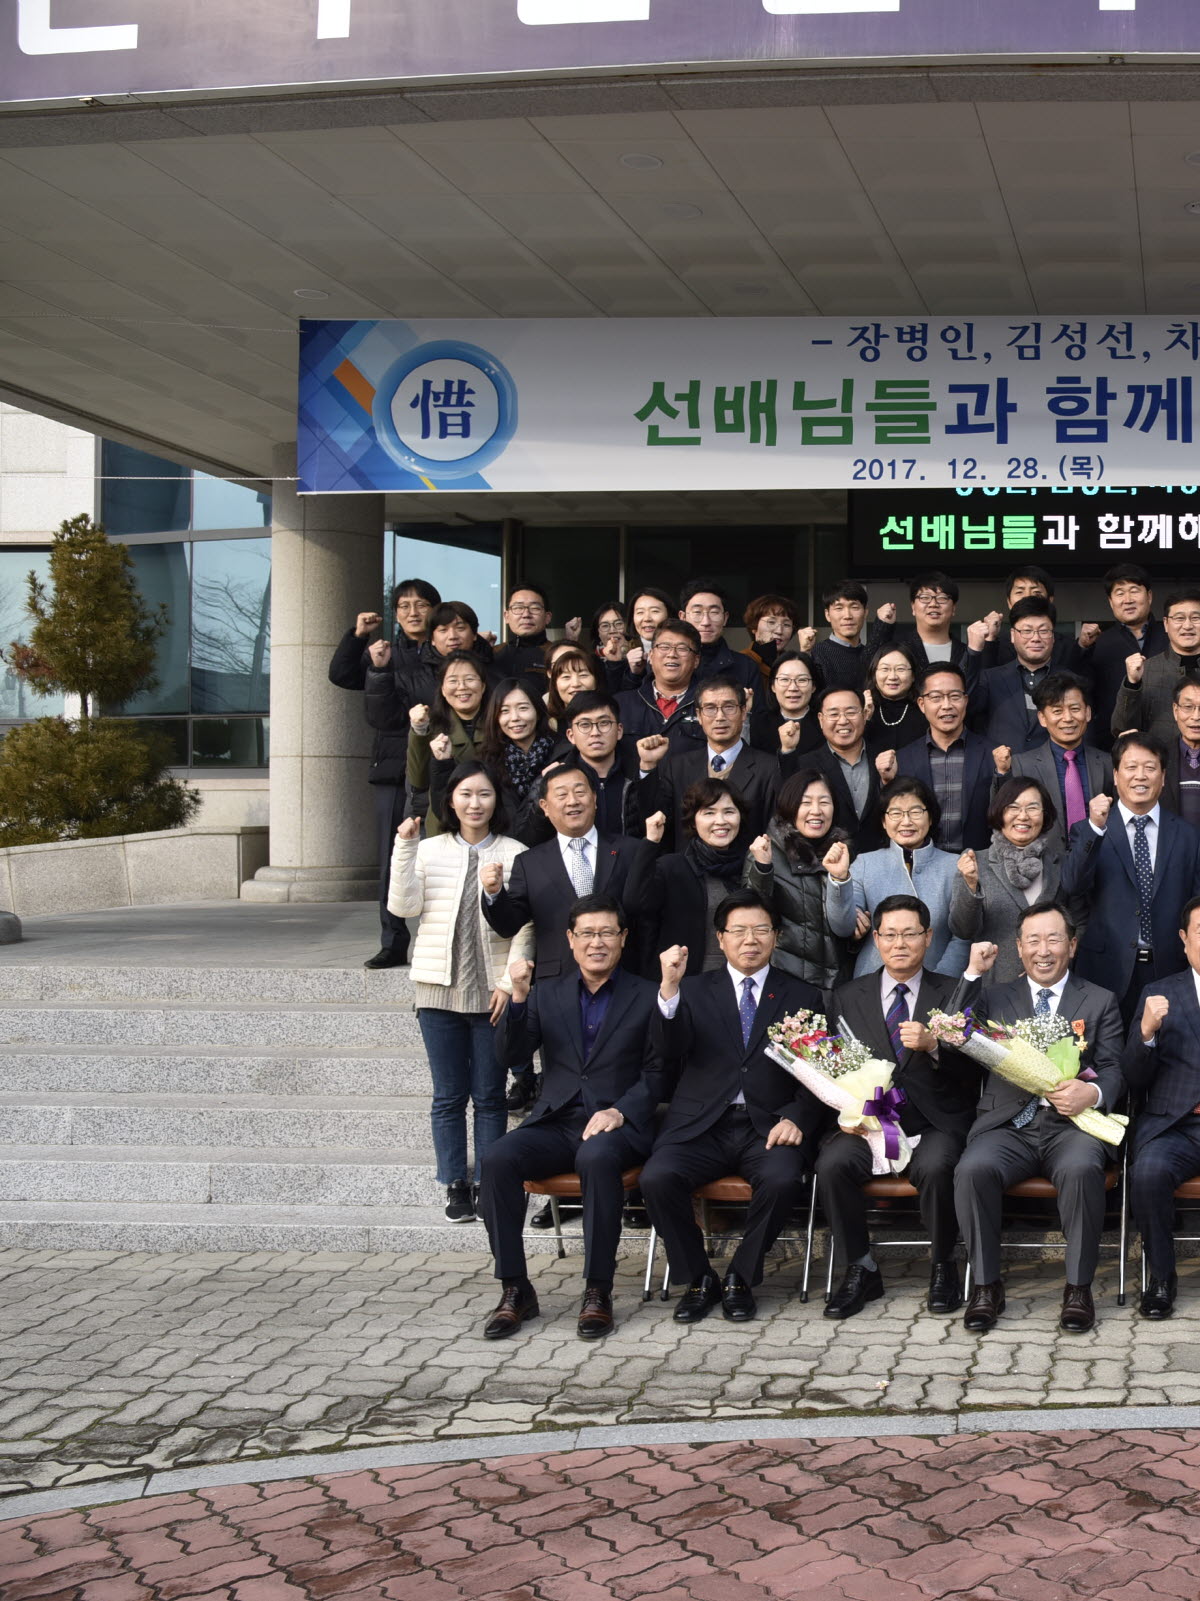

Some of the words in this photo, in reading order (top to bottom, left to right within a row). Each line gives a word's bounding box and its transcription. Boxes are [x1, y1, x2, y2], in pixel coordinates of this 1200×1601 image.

[410, 379, 476, 439] 惜
[634, 378, 1017, 446] 선배님들과
[852, 458, 926, 481] 2017.
[948, 458, 986, 480] 12.
[879, 515, 1080, 550] 선배님들과
